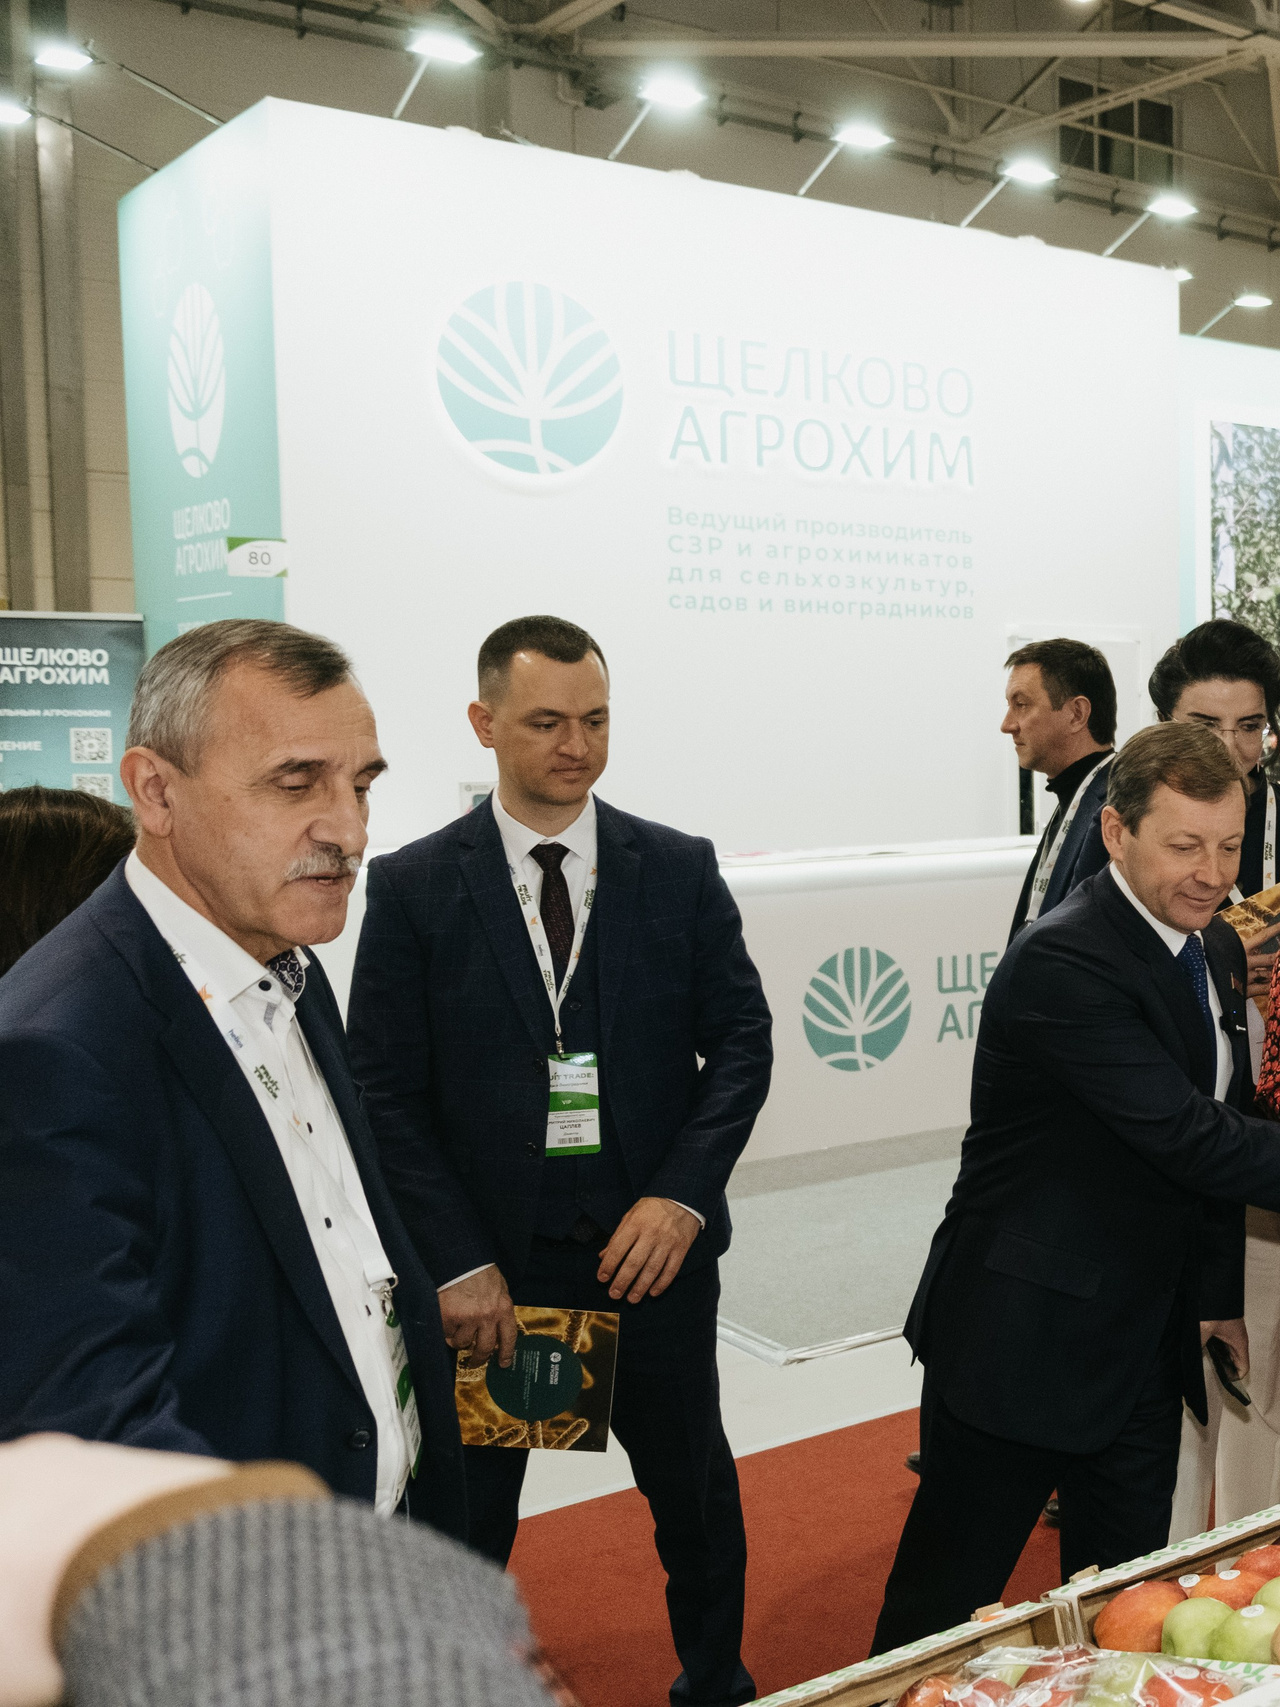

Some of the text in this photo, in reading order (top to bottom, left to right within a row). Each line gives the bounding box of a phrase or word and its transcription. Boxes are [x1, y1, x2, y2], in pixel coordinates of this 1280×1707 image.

[667, 329, 975, 419] ЩЕЛКОВО
[669, 405, 975, 487] АГРОХИМ
[173, 498, 231, 540] ЩЕЛКОВО
[667, 506, 973, 544] Ведущий производитель
[249, 551, 271, 565] 80
[667, 535, 974, 570] СЗР и агрохимикатов
[667, 565, 975, 597] для сельхозкультур,
[668, 593, 975, 620] садов и виноградников
[0, 648, 109, 667] ЩЕЛКОВО
[0, 667, 110, 685] АГРОХИМ
